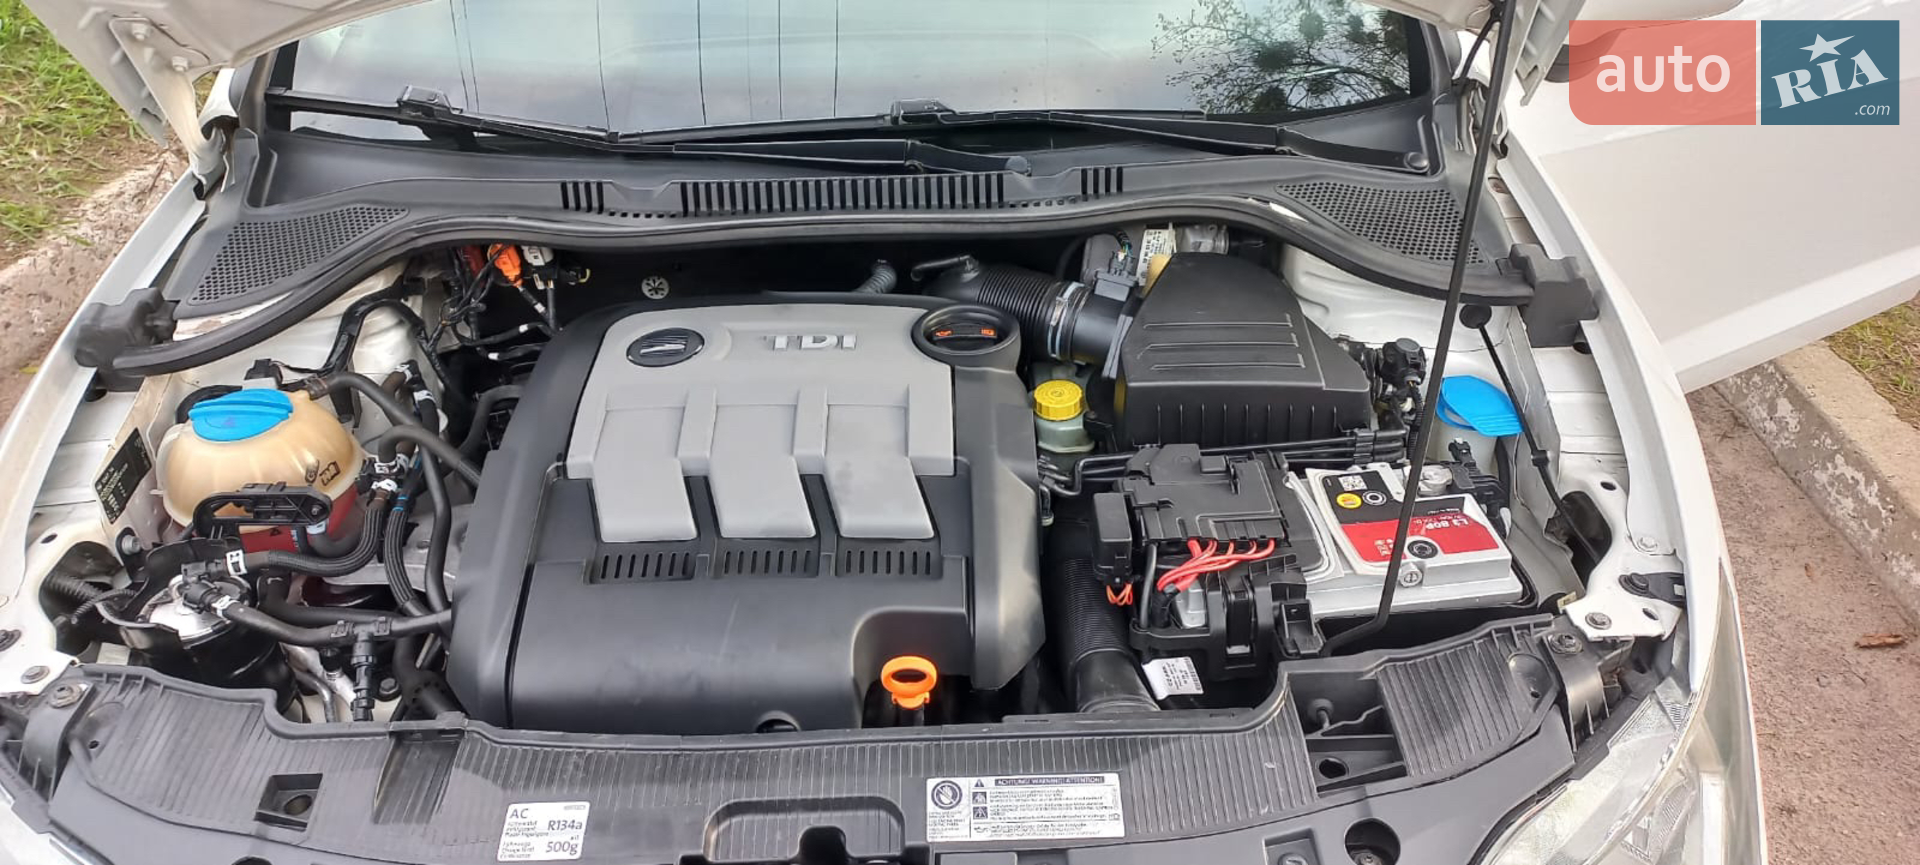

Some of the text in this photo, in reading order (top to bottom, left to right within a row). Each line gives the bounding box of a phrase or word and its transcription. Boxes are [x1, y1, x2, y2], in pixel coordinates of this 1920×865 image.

[763, 333, 858, 350] TDI
[509, 808, 529, 819] AC
[547, 819, 583, 831] R134a
[545, 841, 579, 856] 500g
